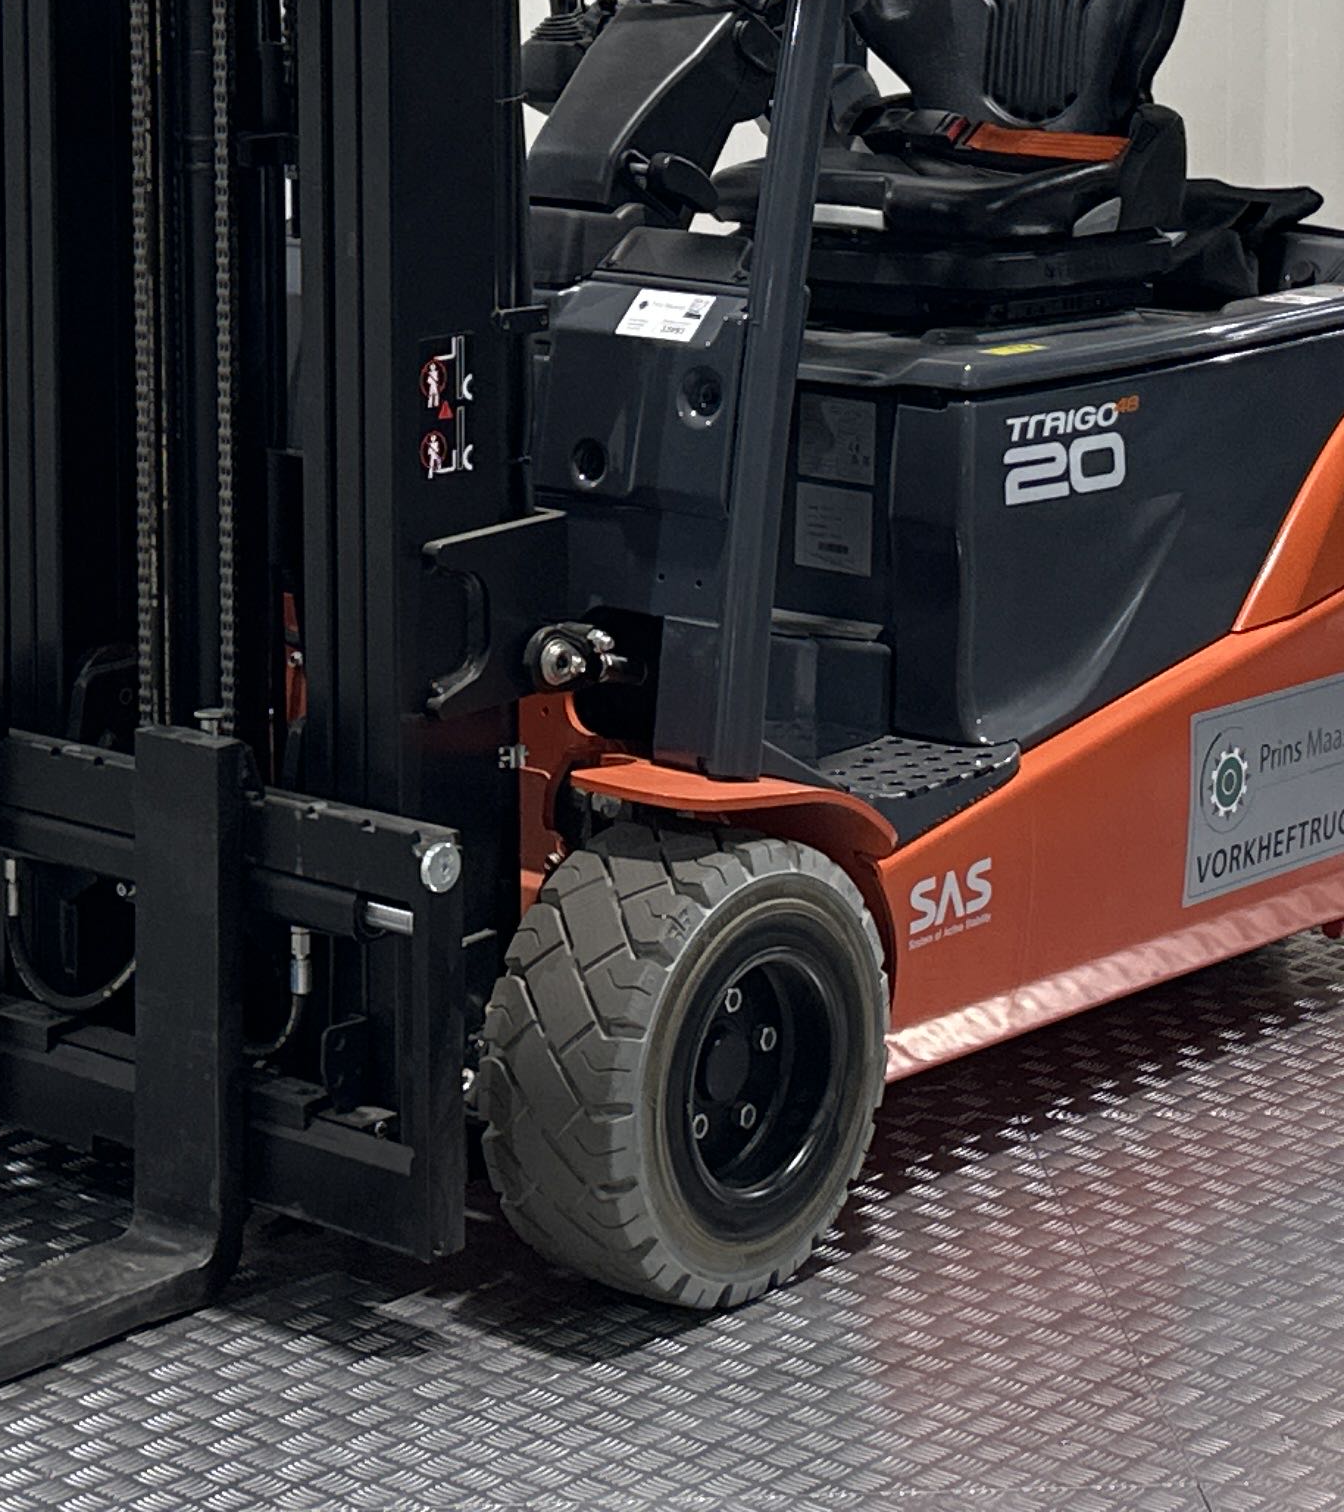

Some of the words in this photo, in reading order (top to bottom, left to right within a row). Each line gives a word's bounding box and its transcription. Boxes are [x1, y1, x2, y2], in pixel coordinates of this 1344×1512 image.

[1003, 431, 1126, 506] 20
[1259, 740, 1303, 773] Prins
[909, 856, 992, 935] SAS
